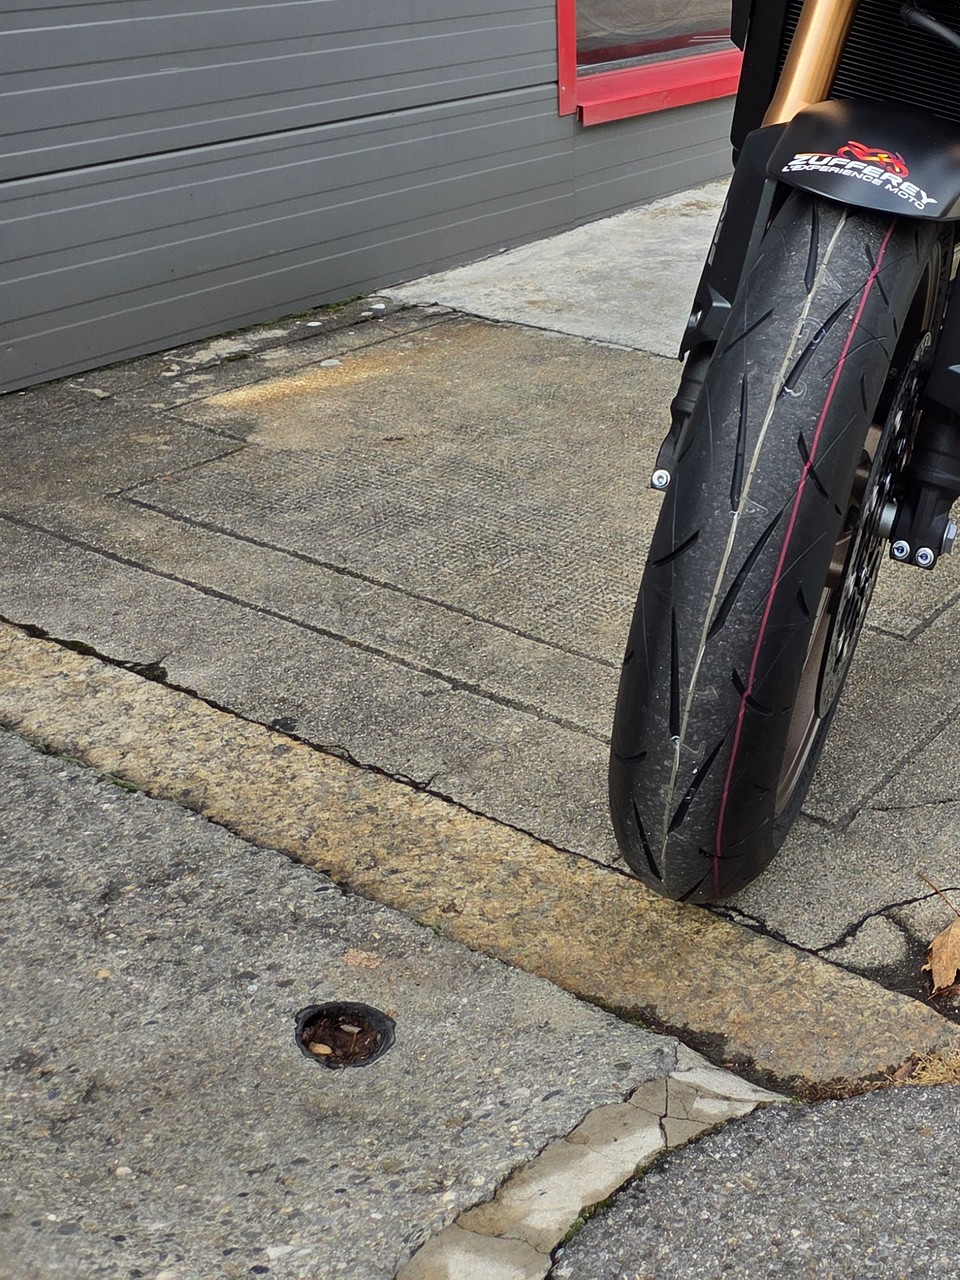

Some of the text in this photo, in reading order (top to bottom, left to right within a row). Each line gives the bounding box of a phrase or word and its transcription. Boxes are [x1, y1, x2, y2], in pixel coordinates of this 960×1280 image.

[781, 164, 925, 210] L'EXPERIENCE MOTO
[788, 153, 938, 205] ZUFFEREY
